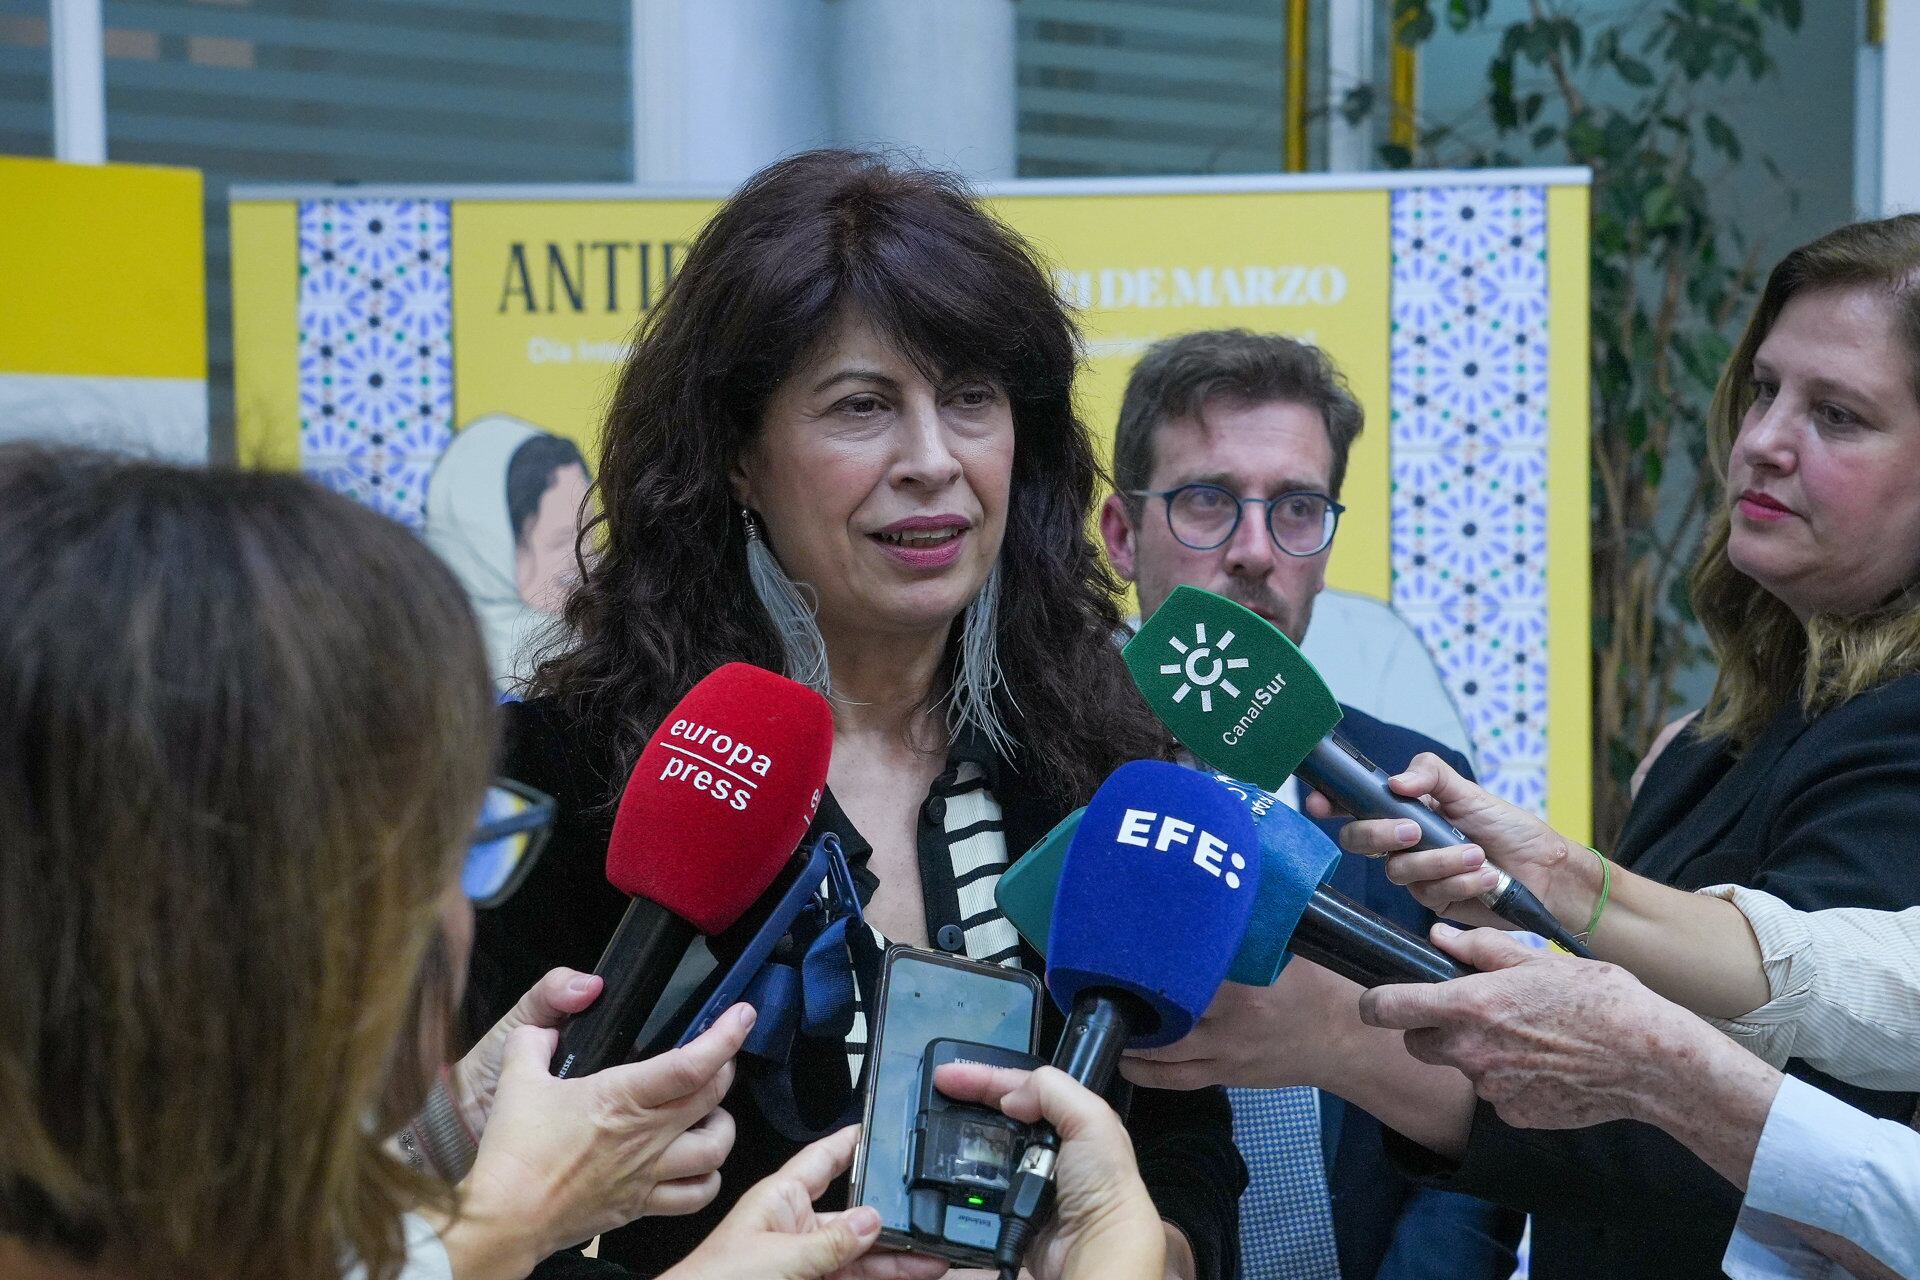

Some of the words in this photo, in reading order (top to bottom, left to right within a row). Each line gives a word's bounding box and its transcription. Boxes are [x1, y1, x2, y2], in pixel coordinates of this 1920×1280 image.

[1098, 266, 1166, 309] DE
[1171, 264, 1348, 308] MARZO
[1222, 672, 1287, 746] CanalSur
[670, 718, 773, 777] europa
[659, 755, 752, 811] press
